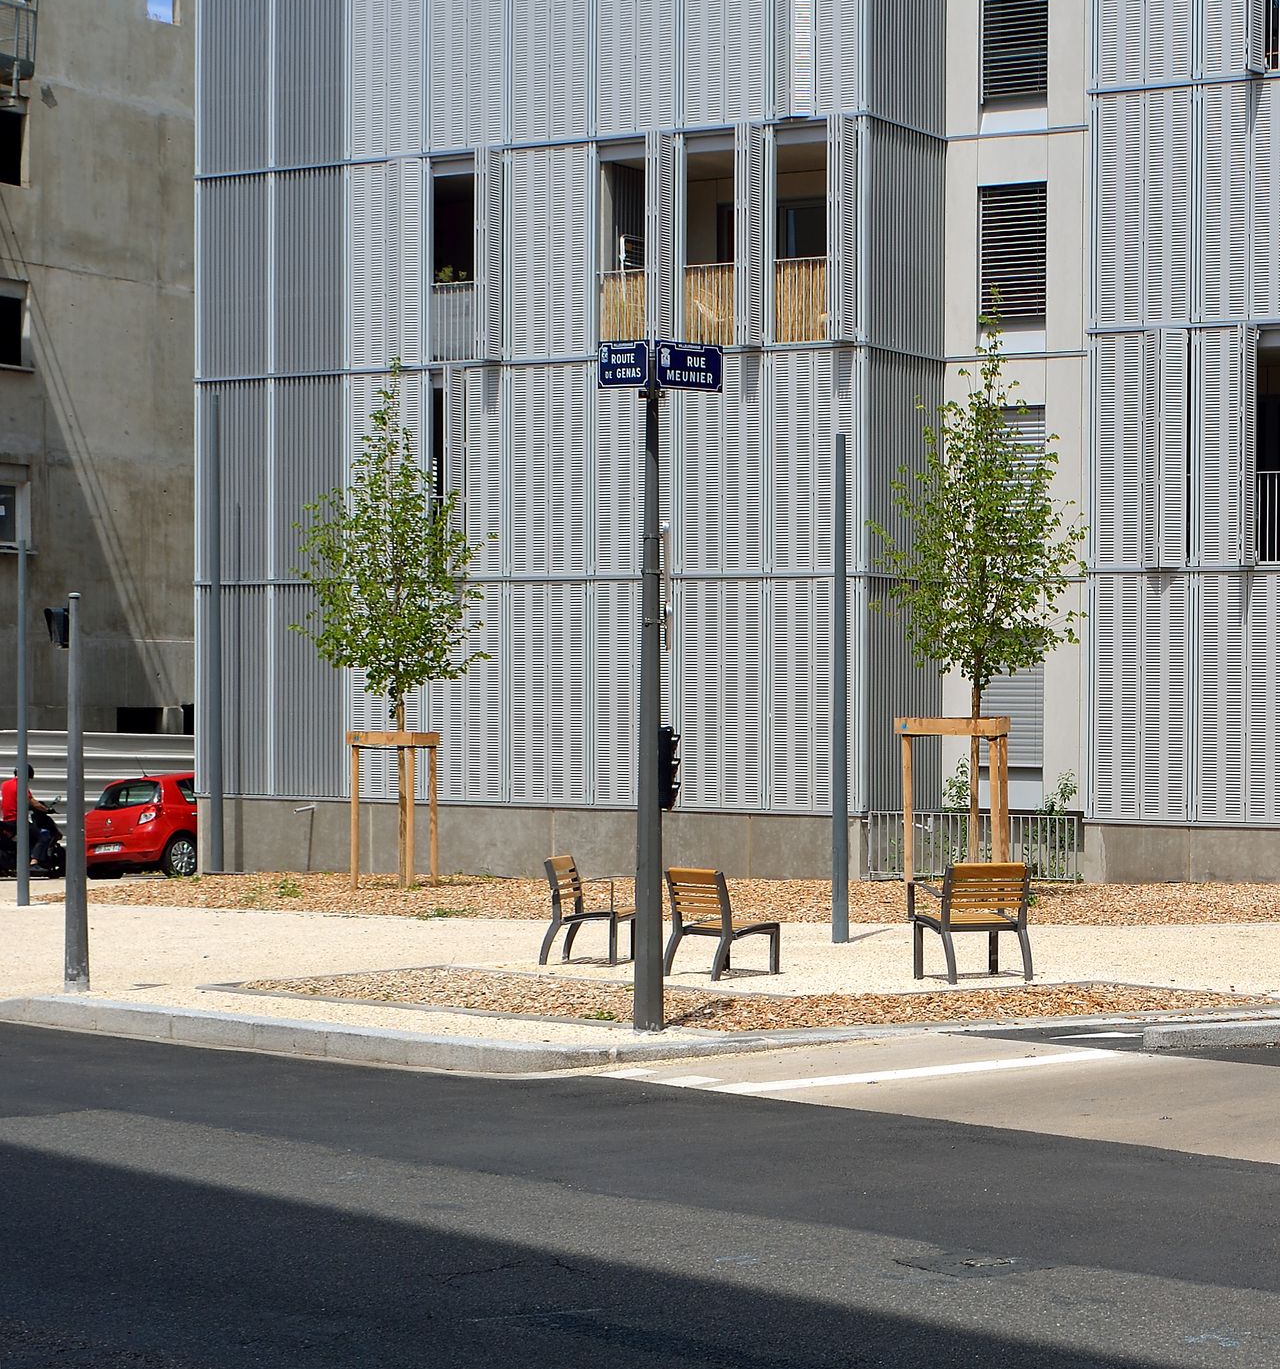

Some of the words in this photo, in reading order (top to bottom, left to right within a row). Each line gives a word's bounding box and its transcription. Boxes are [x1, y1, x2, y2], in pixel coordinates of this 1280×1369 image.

[611, 353, 635, 364] ROUTE
[687, 356, 706, 368] RUE
[604, 371, 613, 379] DE
[616, 367, 641, 378] GENAS
[667, 370, 713, 384] MEUNIER
